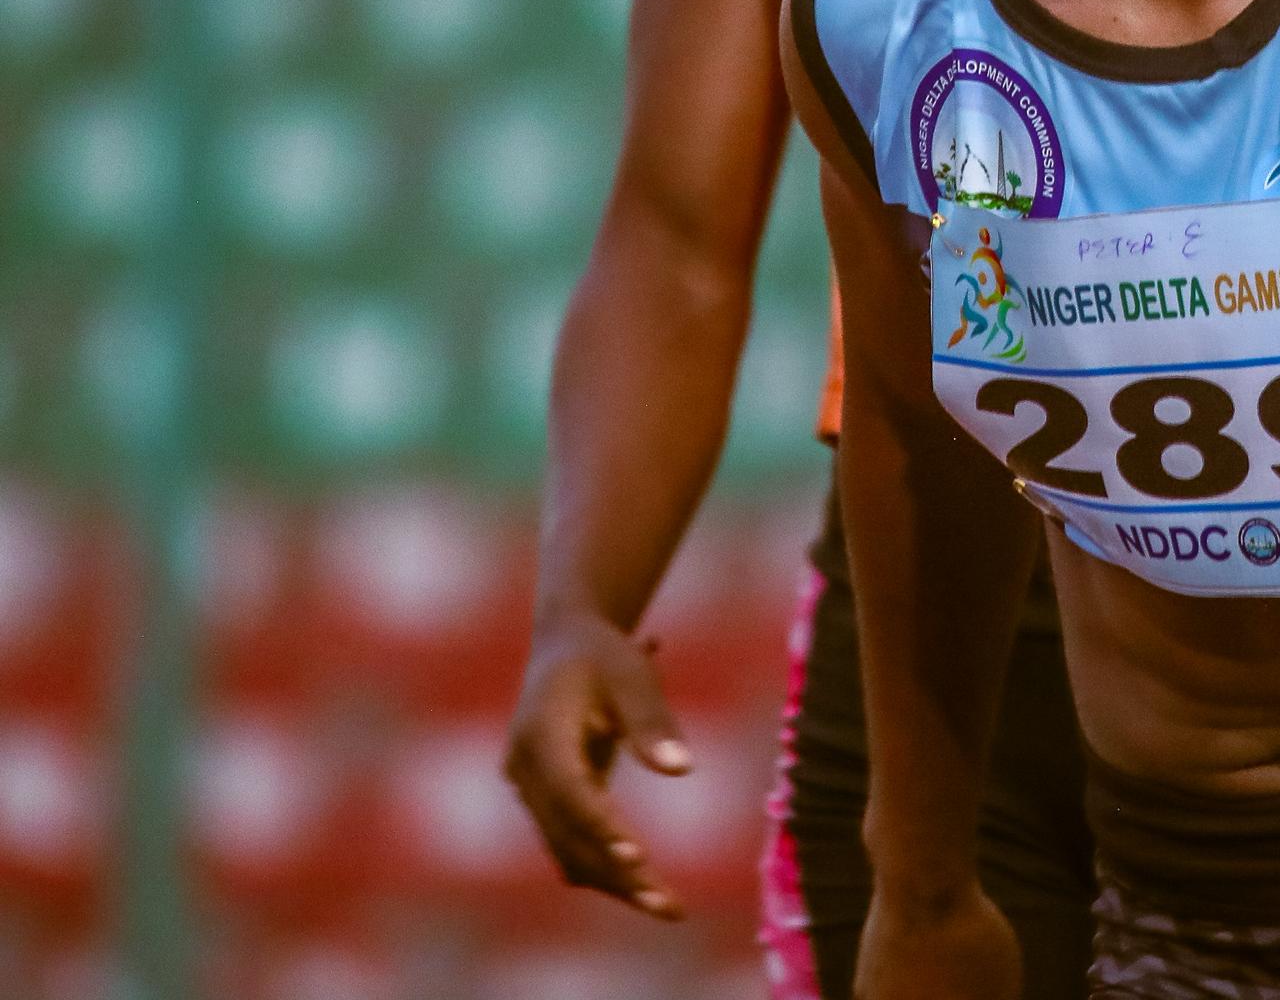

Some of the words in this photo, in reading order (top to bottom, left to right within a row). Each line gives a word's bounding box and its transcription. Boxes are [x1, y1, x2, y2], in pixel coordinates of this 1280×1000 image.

[922, 75, 949, 118] DELTA
[917, 119, 930, 170] NIGER
[1019, 96, 1055, 198] COMMISSION
[1026, 283, 1116, 327] NIGER
[1119, 276, 1210, 321] DELTA
[1117, 522, 1232, 563] NDDC
